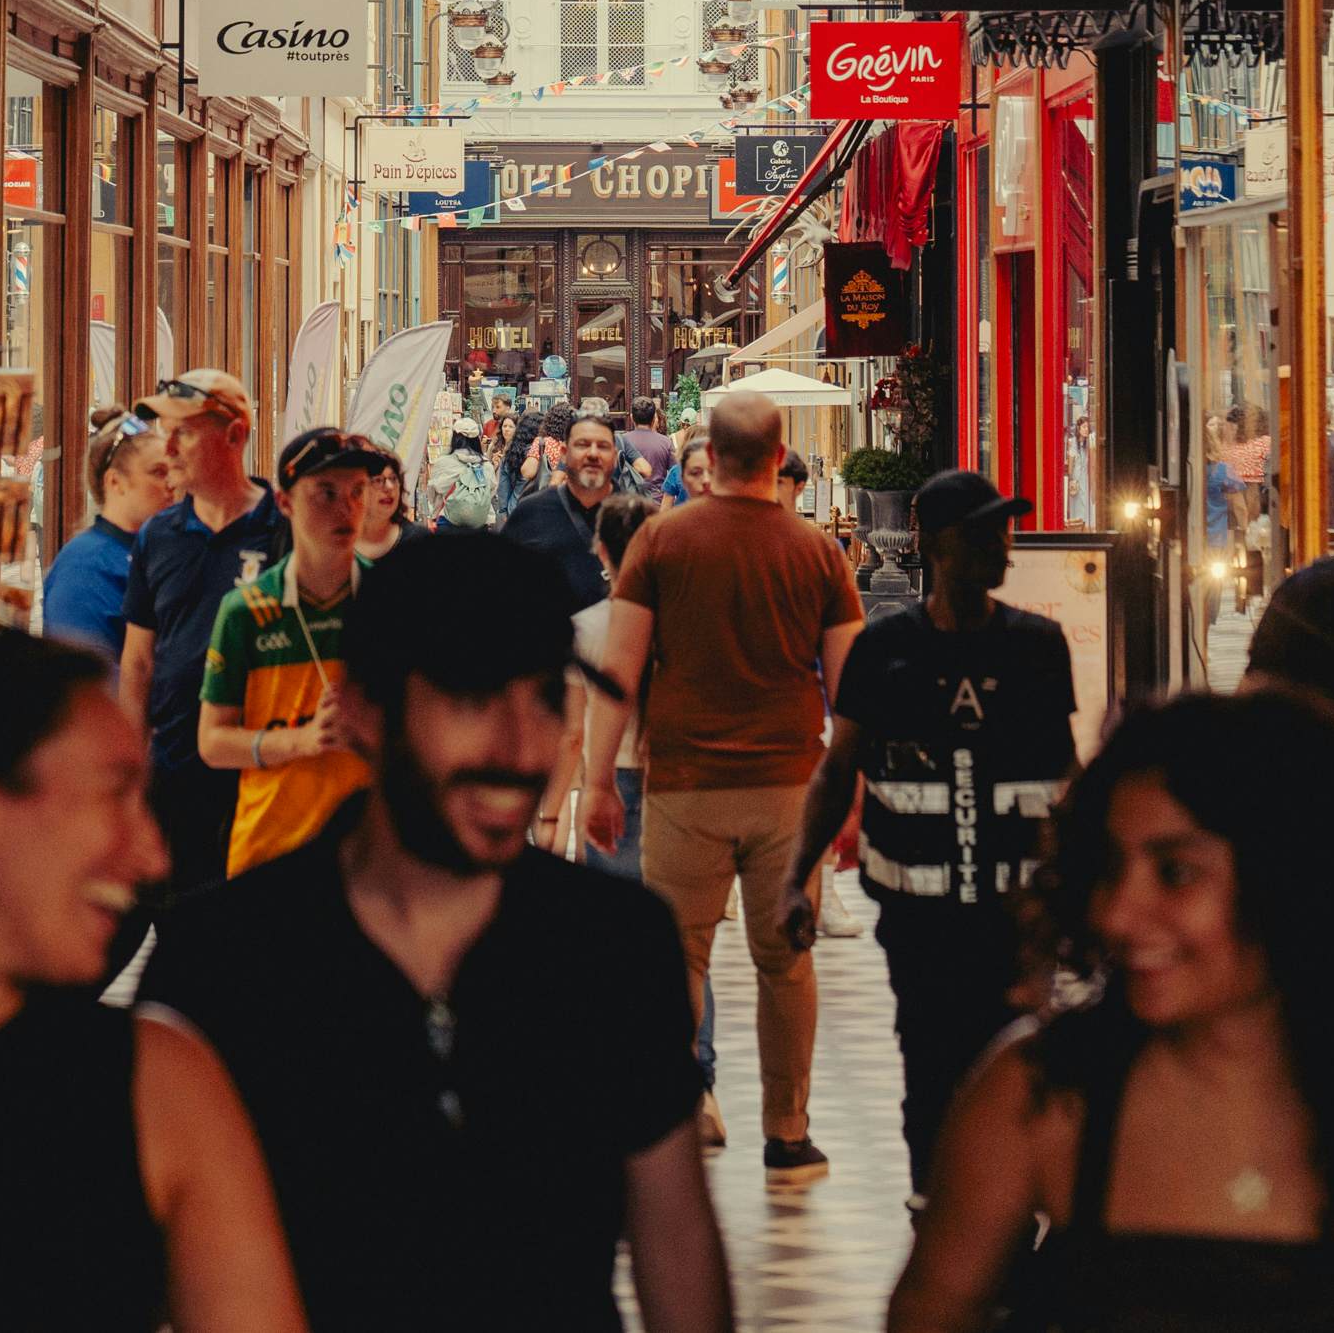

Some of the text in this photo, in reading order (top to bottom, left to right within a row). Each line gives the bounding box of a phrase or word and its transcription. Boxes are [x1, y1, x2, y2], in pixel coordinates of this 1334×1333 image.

[217, 20, 350, 55] Casino
[286, 50, 350, 63] #toutprès
[860, 95, 909, 105] La Boutique
[374, 164, 402, 179] Pain
[469, 327, 533, 349] HOTEL
[581, 327, 623, 341] HOTEL
[674, 327, 737, 349] HOTEL
